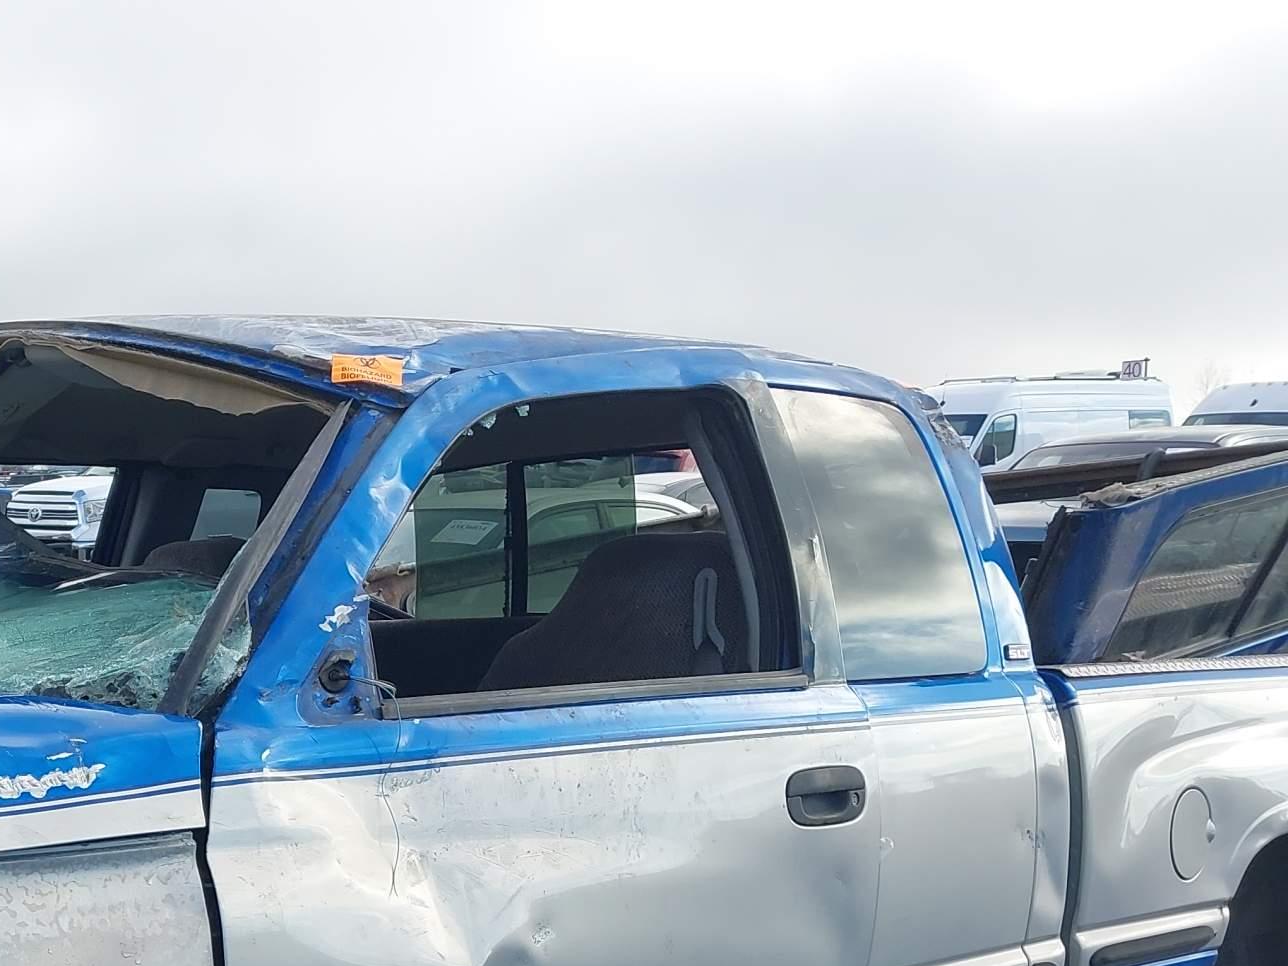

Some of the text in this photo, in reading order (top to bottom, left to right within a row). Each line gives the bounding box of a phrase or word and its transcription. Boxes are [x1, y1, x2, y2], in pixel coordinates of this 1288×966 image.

[341, 366, 393, 380] BIOHAZARD
[1123, 362, 1142, 378] 40
[1008, 649, 1030, 659] SLT
